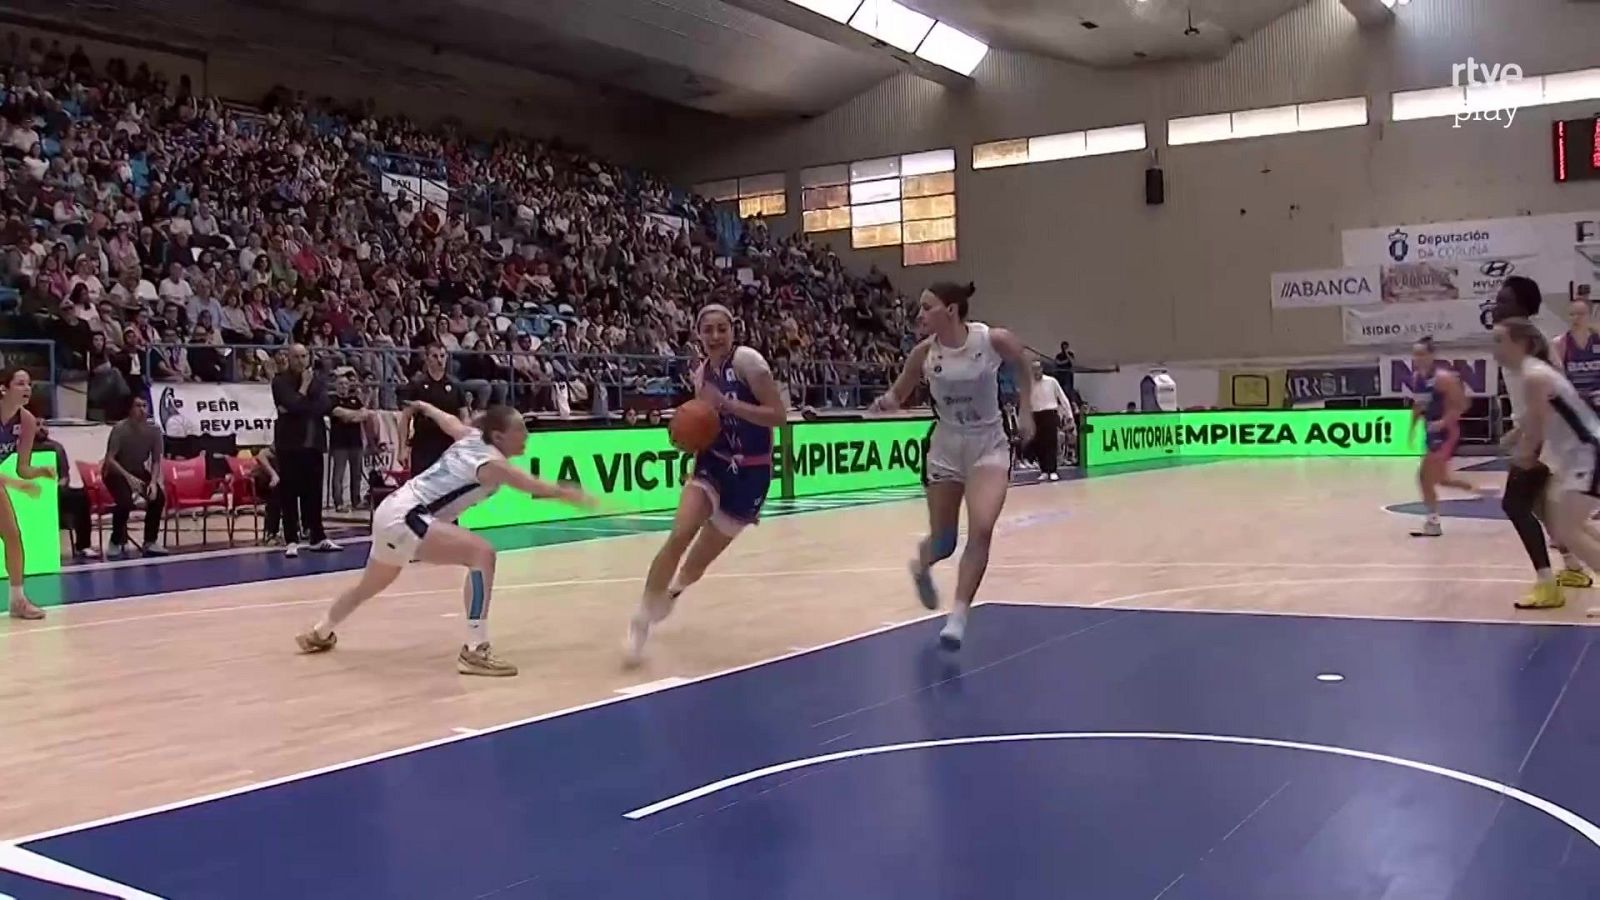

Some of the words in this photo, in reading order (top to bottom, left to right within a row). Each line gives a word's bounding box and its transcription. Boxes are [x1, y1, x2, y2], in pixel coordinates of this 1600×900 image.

[1417, 230, 1489, 246] Deputación
[197, 398, 239, 412] PEÑA
[234, 418, 273, 431] PLAT
[1103, 429, 1119, 451] LA
[1121, 425, 1173, 450] VICTORIA
[1175, 423, 1297, 446] EMPIEZA
[1305, 417, 1392, 448] AQUÍ!
[888, 438, 926, 474] AQ
